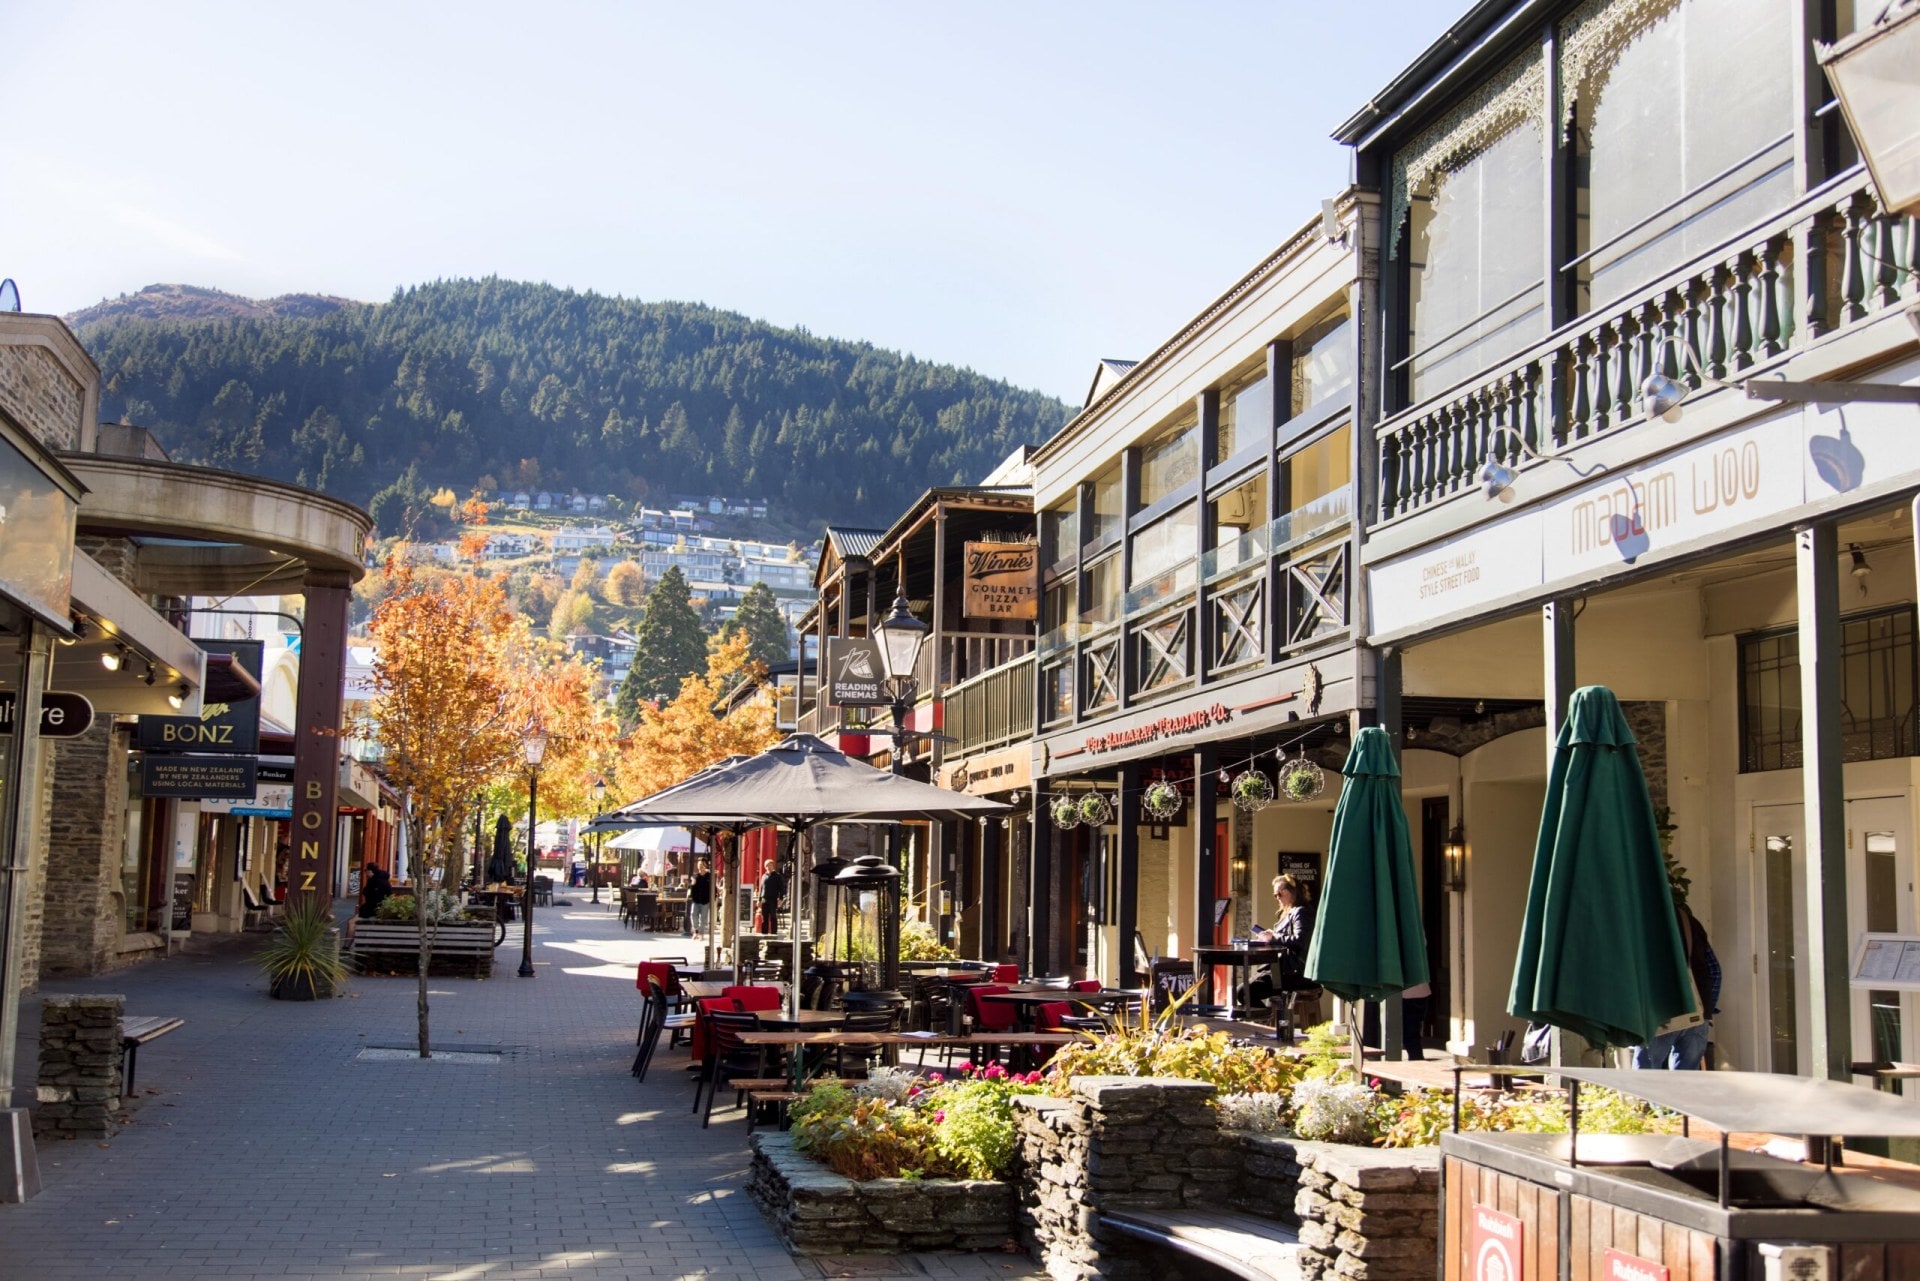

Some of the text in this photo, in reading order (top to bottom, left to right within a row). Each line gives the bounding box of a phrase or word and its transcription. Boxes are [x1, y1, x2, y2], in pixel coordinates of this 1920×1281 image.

[1693, 440, 1760, 515] WOO
[968, 549, 1034, 579] Winnies
[1423, 560, 1448, 581] CHINESE
[1456, 551, 1476, 569] MALAY
[1420, 566, 1480, 600] STYLE STREET FOOD
[972, 585, 1032, 595] GOURMET
[984, 595, 1018, 603] PIZZA
[990, 604, 1012, 612] BAR
[835, 683, 878, 691] READING
[835, 690, 878, 699] CINEMAS
[163, 723, 234, 743] BONZ
[1086, 735, 1103, 751] THE
[1105, 723, 1155, 747] BALLARAT
[1156, 710, 1206, 734] TRADING
[210, 766, 245, 774] ZEALAND
[263, 770, 287, 779] Bunker
[191, 773, 240, 781] ZEALANDERS
[300, 780, 322, 891] BONZ
